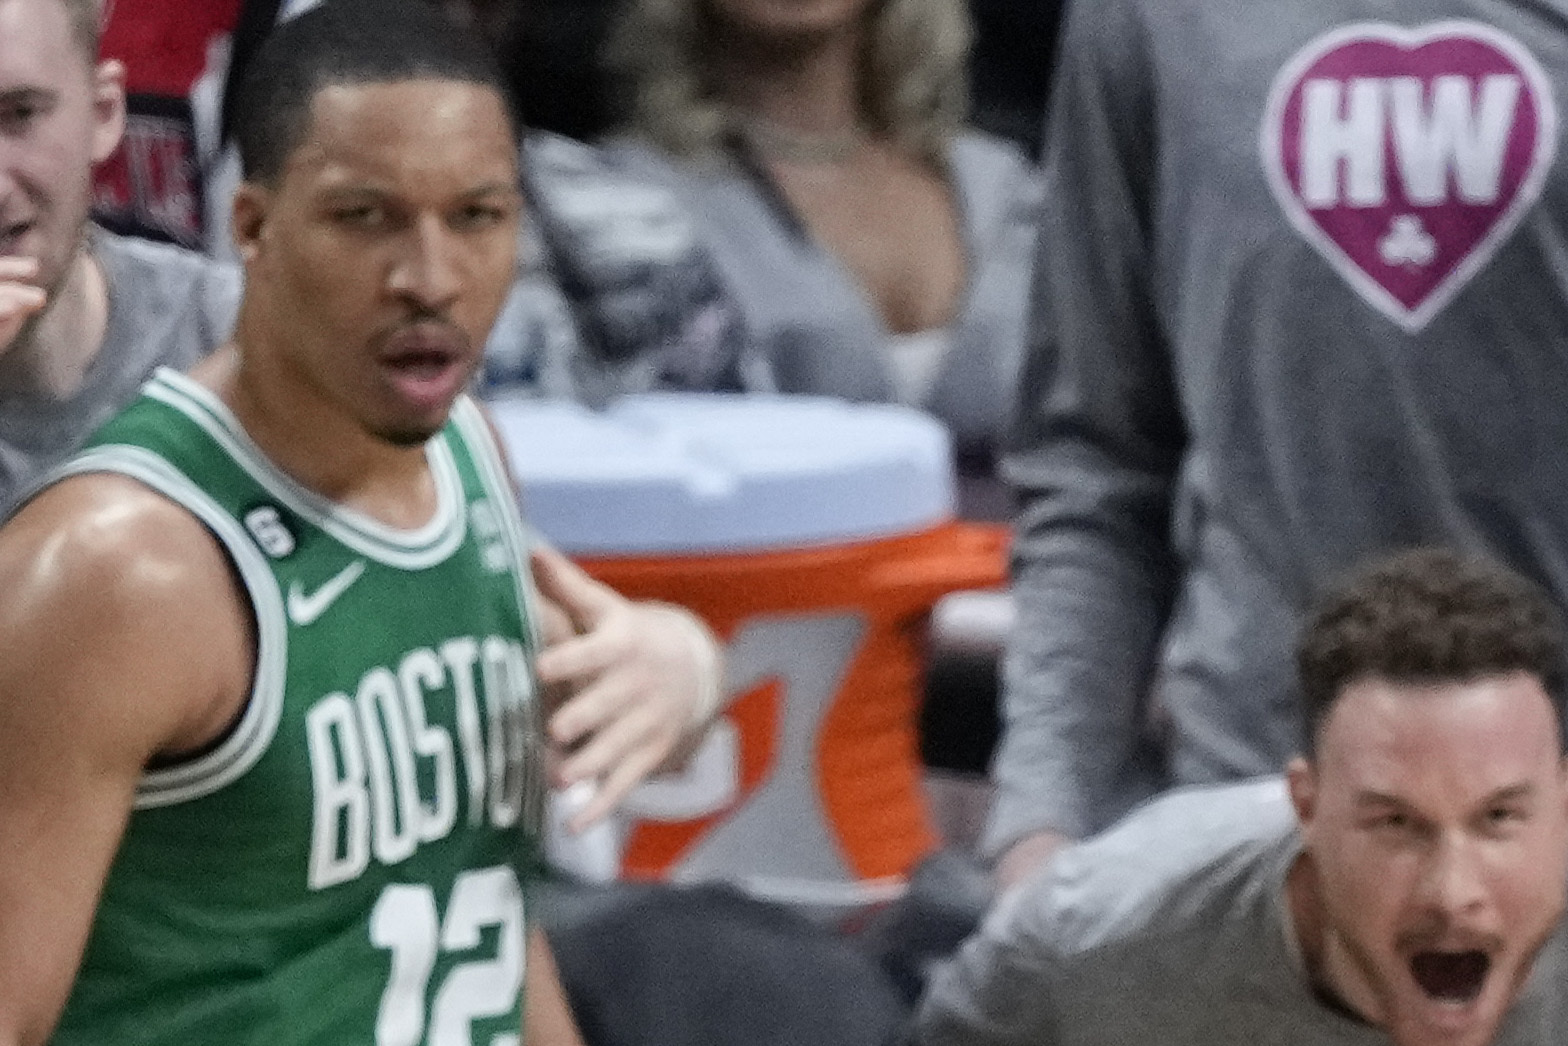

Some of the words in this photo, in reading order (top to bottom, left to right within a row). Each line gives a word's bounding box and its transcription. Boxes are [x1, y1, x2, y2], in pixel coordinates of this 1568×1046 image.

[1304, 74, 1521, 209] HW
[245, 505, 297, 559] 6
[306, 634, 544, 891] BOSTO
